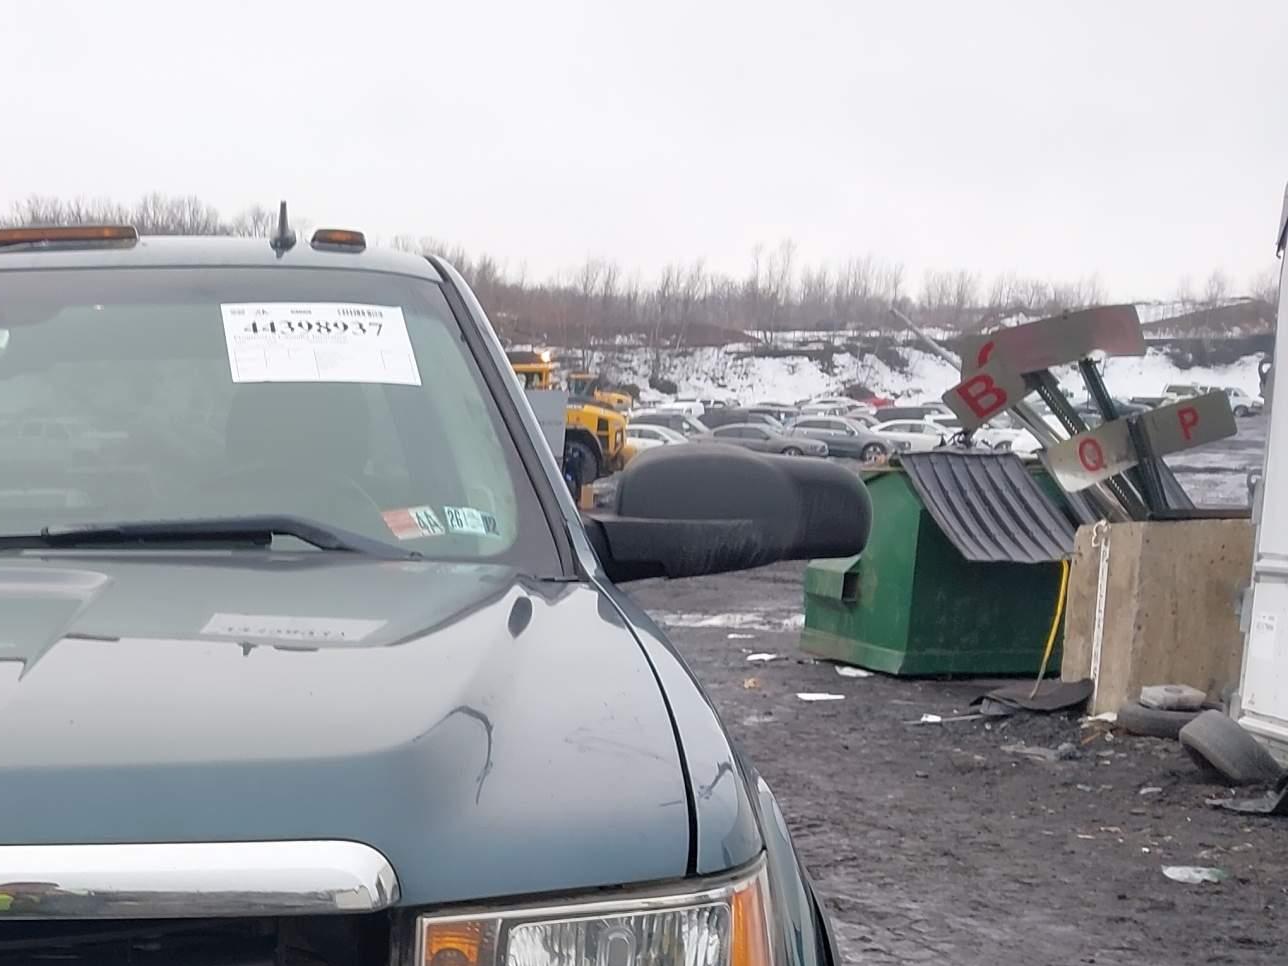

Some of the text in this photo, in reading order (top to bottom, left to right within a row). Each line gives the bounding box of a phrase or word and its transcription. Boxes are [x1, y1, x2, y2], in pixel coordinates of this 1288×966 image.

[244, 316, 383, 337] 44398937
[957, 374, 1007, 418] B
[1177, 406, 1199, 440] P
